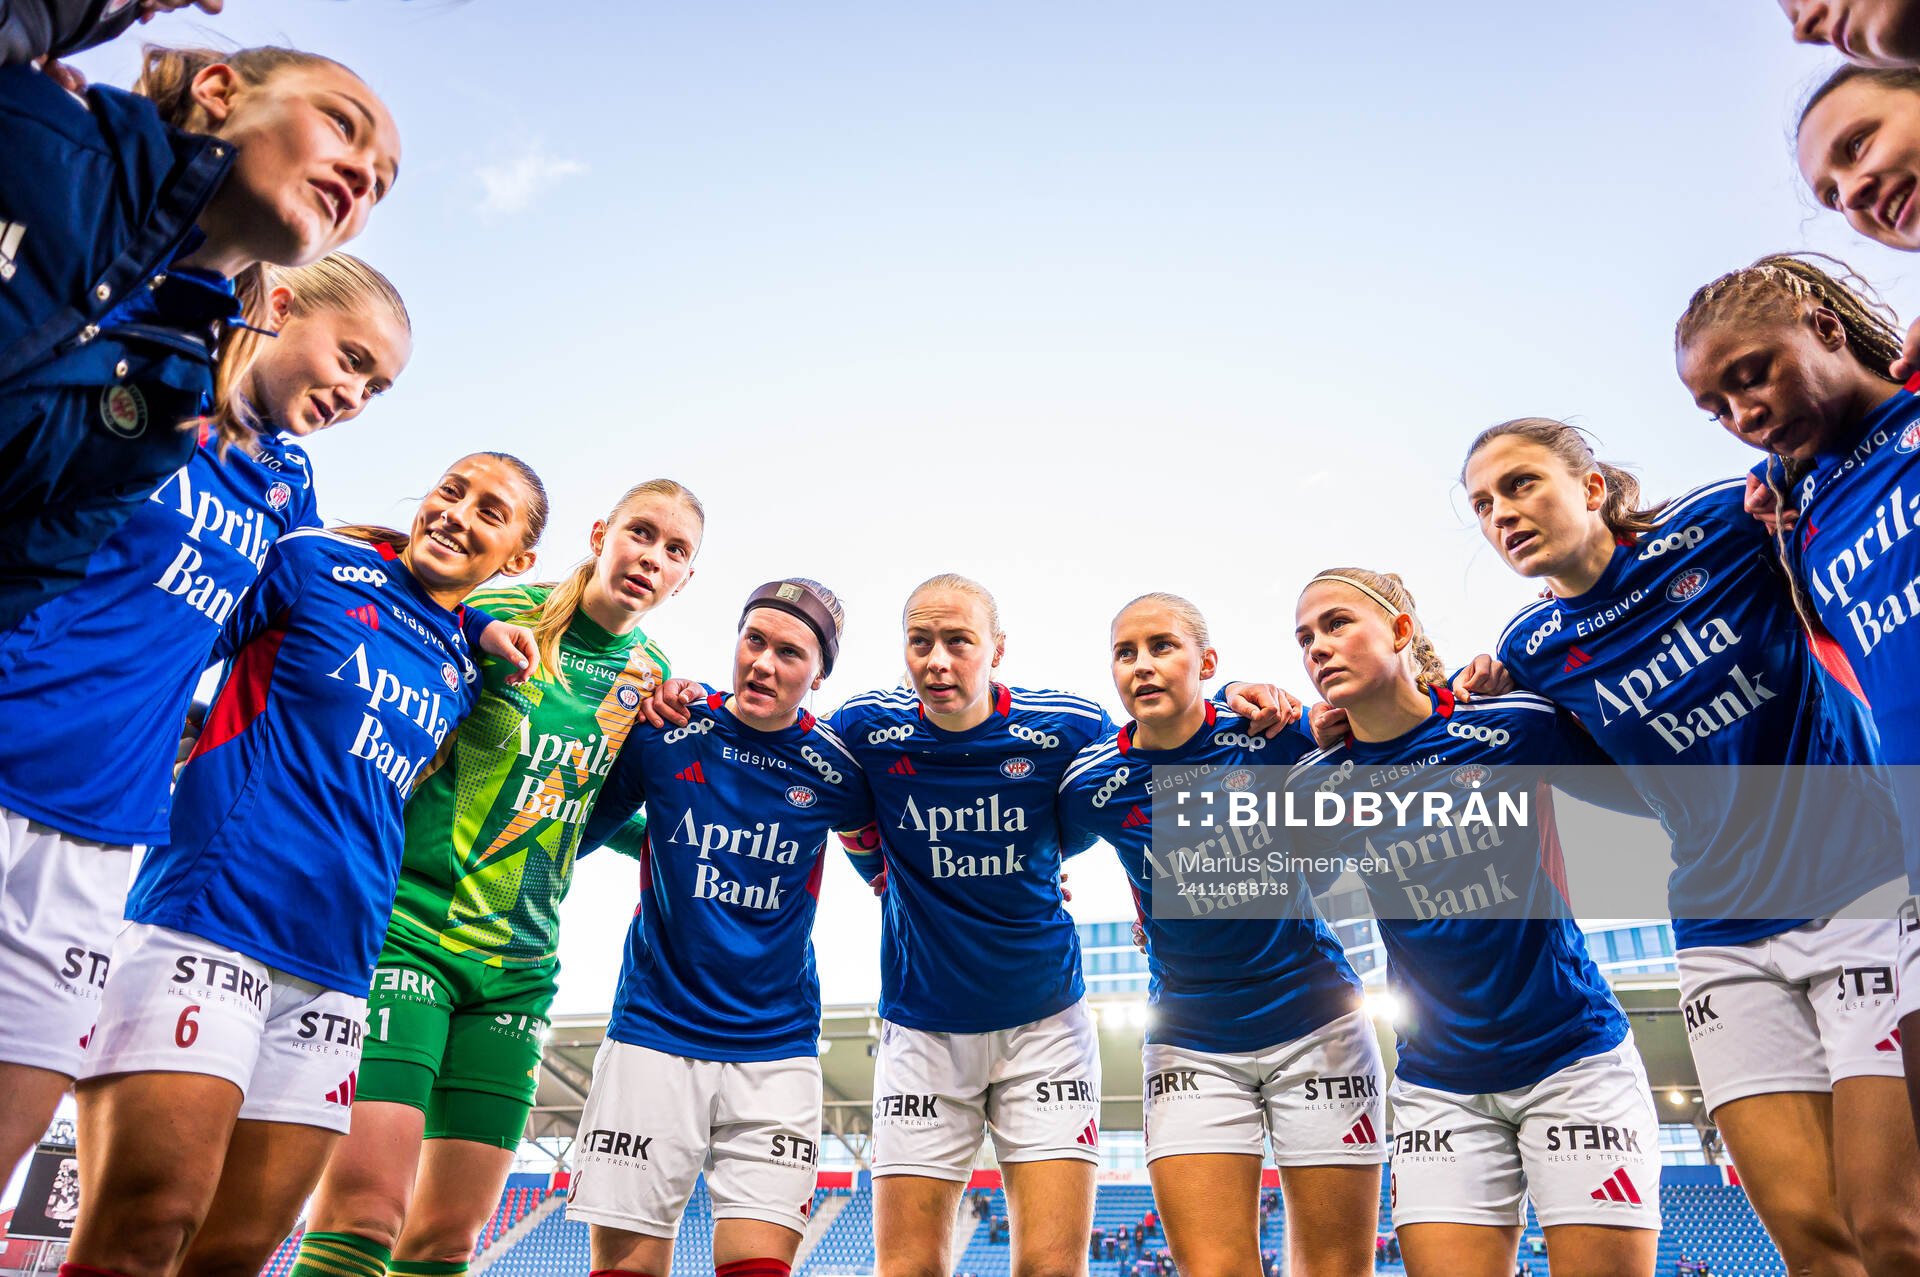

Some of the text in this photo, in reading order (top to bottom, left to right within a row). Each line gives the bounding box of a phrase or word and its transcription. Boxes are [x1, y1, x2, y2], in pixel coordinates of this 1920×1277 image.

[149, 465, 269, 575] Aprila
[332, 566, 388, 588] coop
[1526, 608, 1562, 656] coop
[1594, 617, 1743, 727] Aprila
[325, 642, 448, 751] Aprila
[1646, 663, 1778, 755] Bank
[495, 714, 616, 776] Aprila
[664, 718, 715, 744] coop
[868, 724, 915, 744] coop
[1008, 724, 1060, 749] coop
[1214, 732, 1266, 752] coop
[1447, 722, 1510, 747] coop
[800, 745, 843, 785] coop
[1317, 759, 1354, 794] oop
[1092, 766, 1130, 808] coop
[898, 793, 1029, 842] Aprila
[667, 807, 799, 864] Aprila
[856, 826, 879, 850] C
[1141, 819, 1274, 886] Aprila
[1364, 809, 1505, 882] Aprila
[929, 844, 1027, 878] Bank
[692, 862, 787, 910] Bank
[1402, 864, 1519, 921] Bank
[168, 987, 211, 1000] HELSE
[394, 993, 438, 1008] TRENING
[175, 1005, 201, 1049] 6
[490, 1025, 521, 1040] HELSE
[292, 1041, 329, 1054] HELSE
[1145, 1071, 1200, 1099] TERK
[1304, 1102, 1334, 1111] HELSE
[607, 1157, 647, 1171] TRENING
[1547, 1154, 1578, 1163] HELSE
